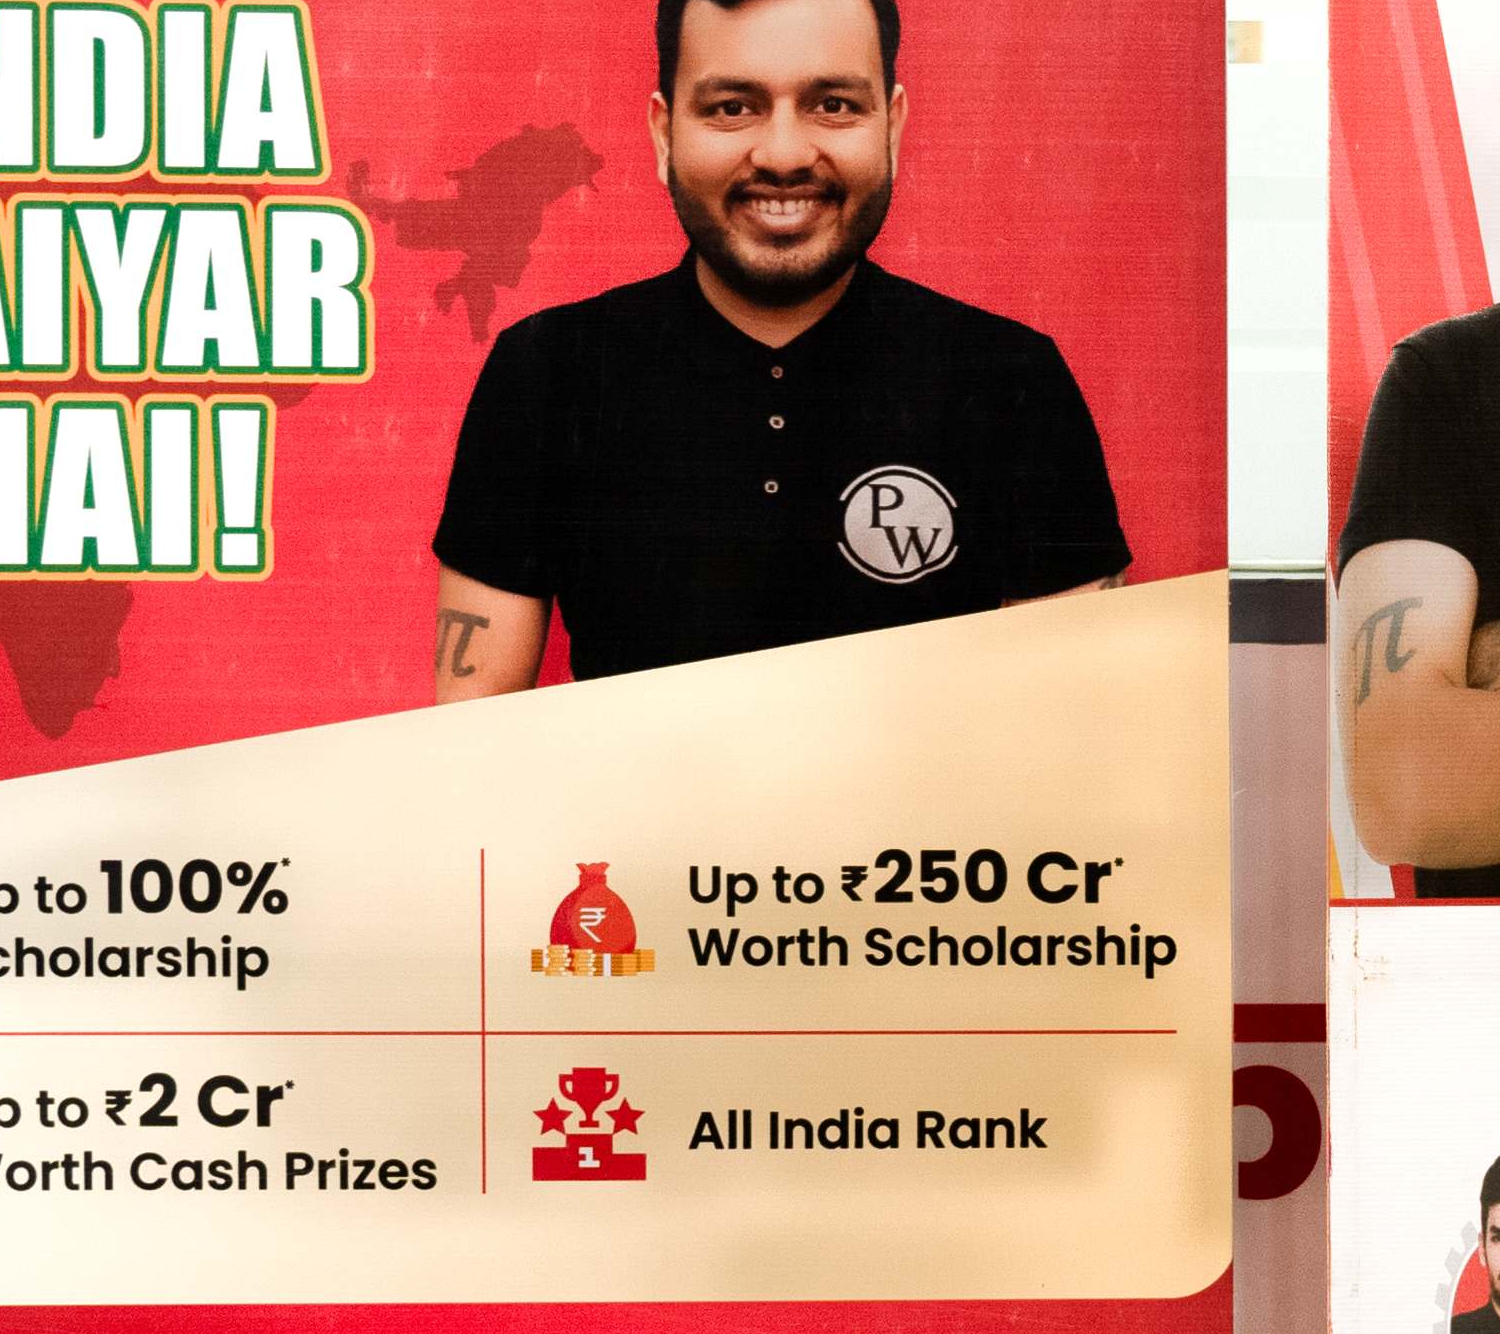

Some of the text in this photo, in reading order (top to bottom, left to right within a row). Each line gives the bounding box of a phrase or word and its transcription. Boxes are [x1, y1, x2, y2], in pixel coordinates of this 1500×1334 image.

[33, 875, 88, 915] to
[689, 865, 825, 918] Up to
[687, 922, 1178, 980] Worth Scholarship
[35, 1089, 90, 1129] to
[688, 1106, 1048, 1150] All India Rank
[129, 1149, 269, 1192] Cash
[285, 1147, 438, 1191] Prizes
